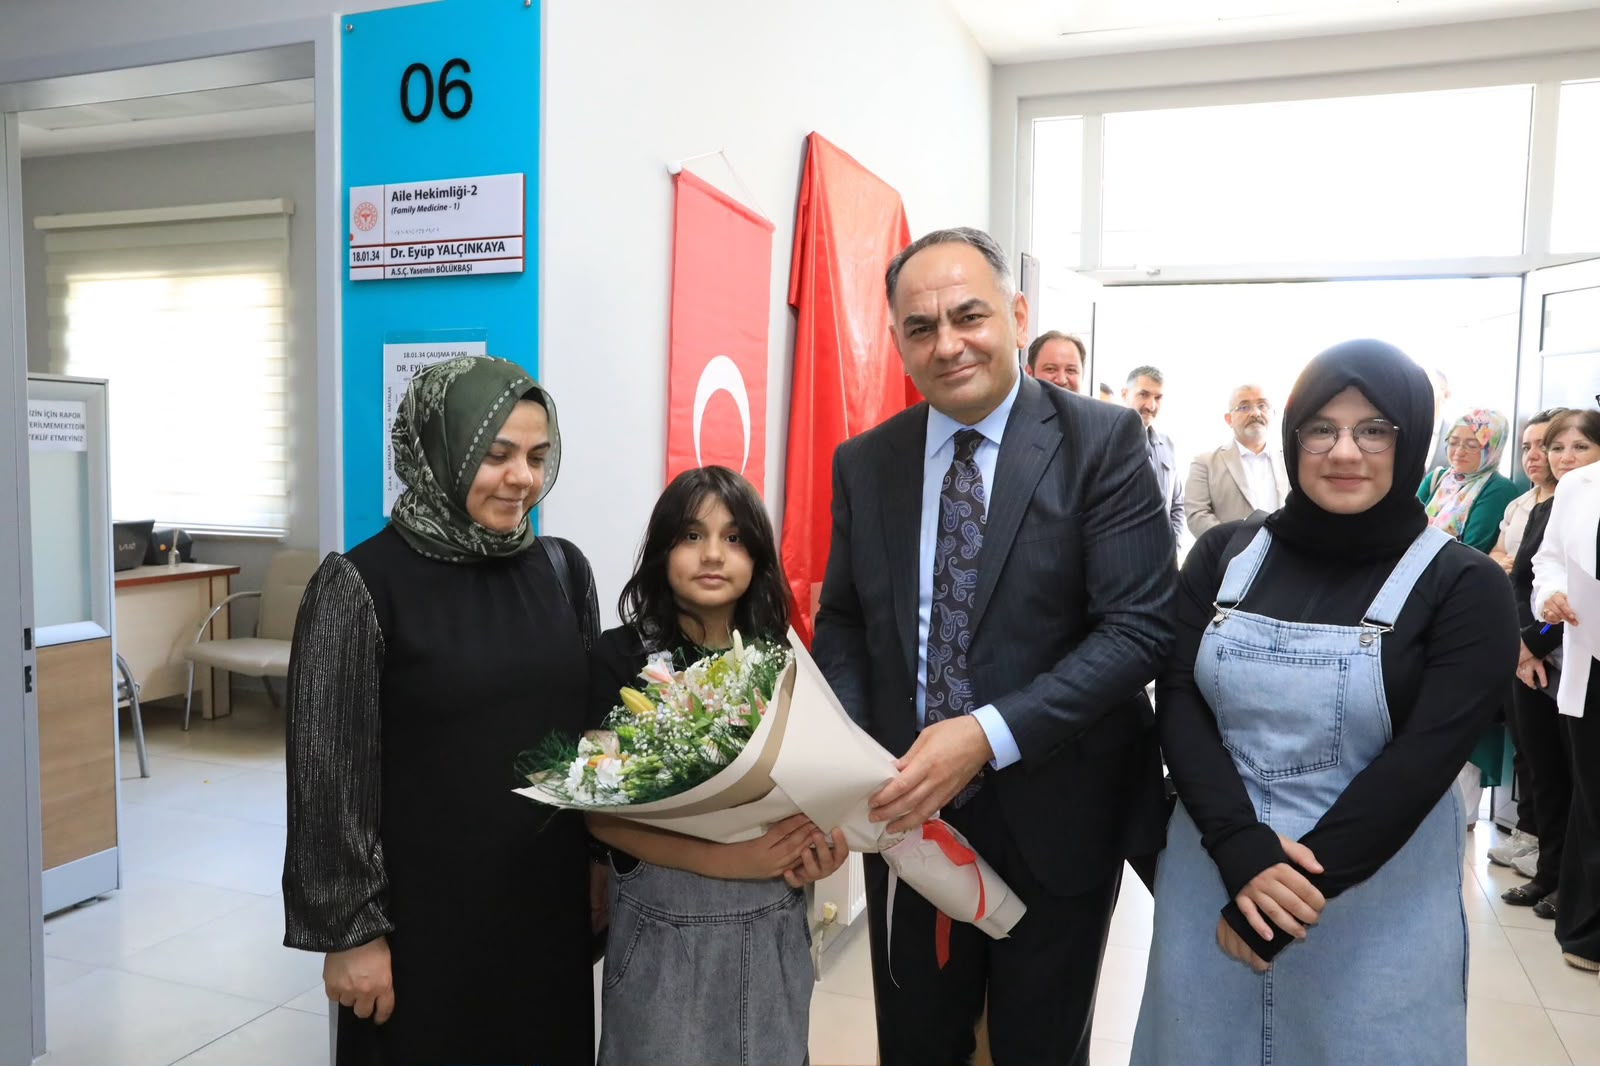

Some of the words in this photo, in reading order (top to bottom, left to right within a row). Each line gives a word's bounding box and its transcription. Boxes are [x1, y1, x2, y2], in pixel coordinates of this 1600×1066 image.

[400, 57, 473, 123] 06
[391, 190, 412, 202] Aile
[414, 185, 478, 200] Hekimliği-2
[390, 205, 416, 215] (Family
[416, 204, 448, 213] Medicine
[453, 203, 460, 211] 1)
[352, 250, 380, 262] 18.01.34
[390, 248, 406, 259] Dr.
[407, 246, 435, 261] Eyüp
[437, 241, 506, 258] YALÇINKAYA
[391, 267, 408, 277] A.S.Ç.
[409, 266, 436, 275] Yasemin
[436, 264, 473, 275] BÖLÜKBAŞI
[426, 351, 450, 359] ÇALIŞMA
[396, 364, 409, 372] DR.
[29, 420, 86, 431] ERİLMEMEKTEDİR
